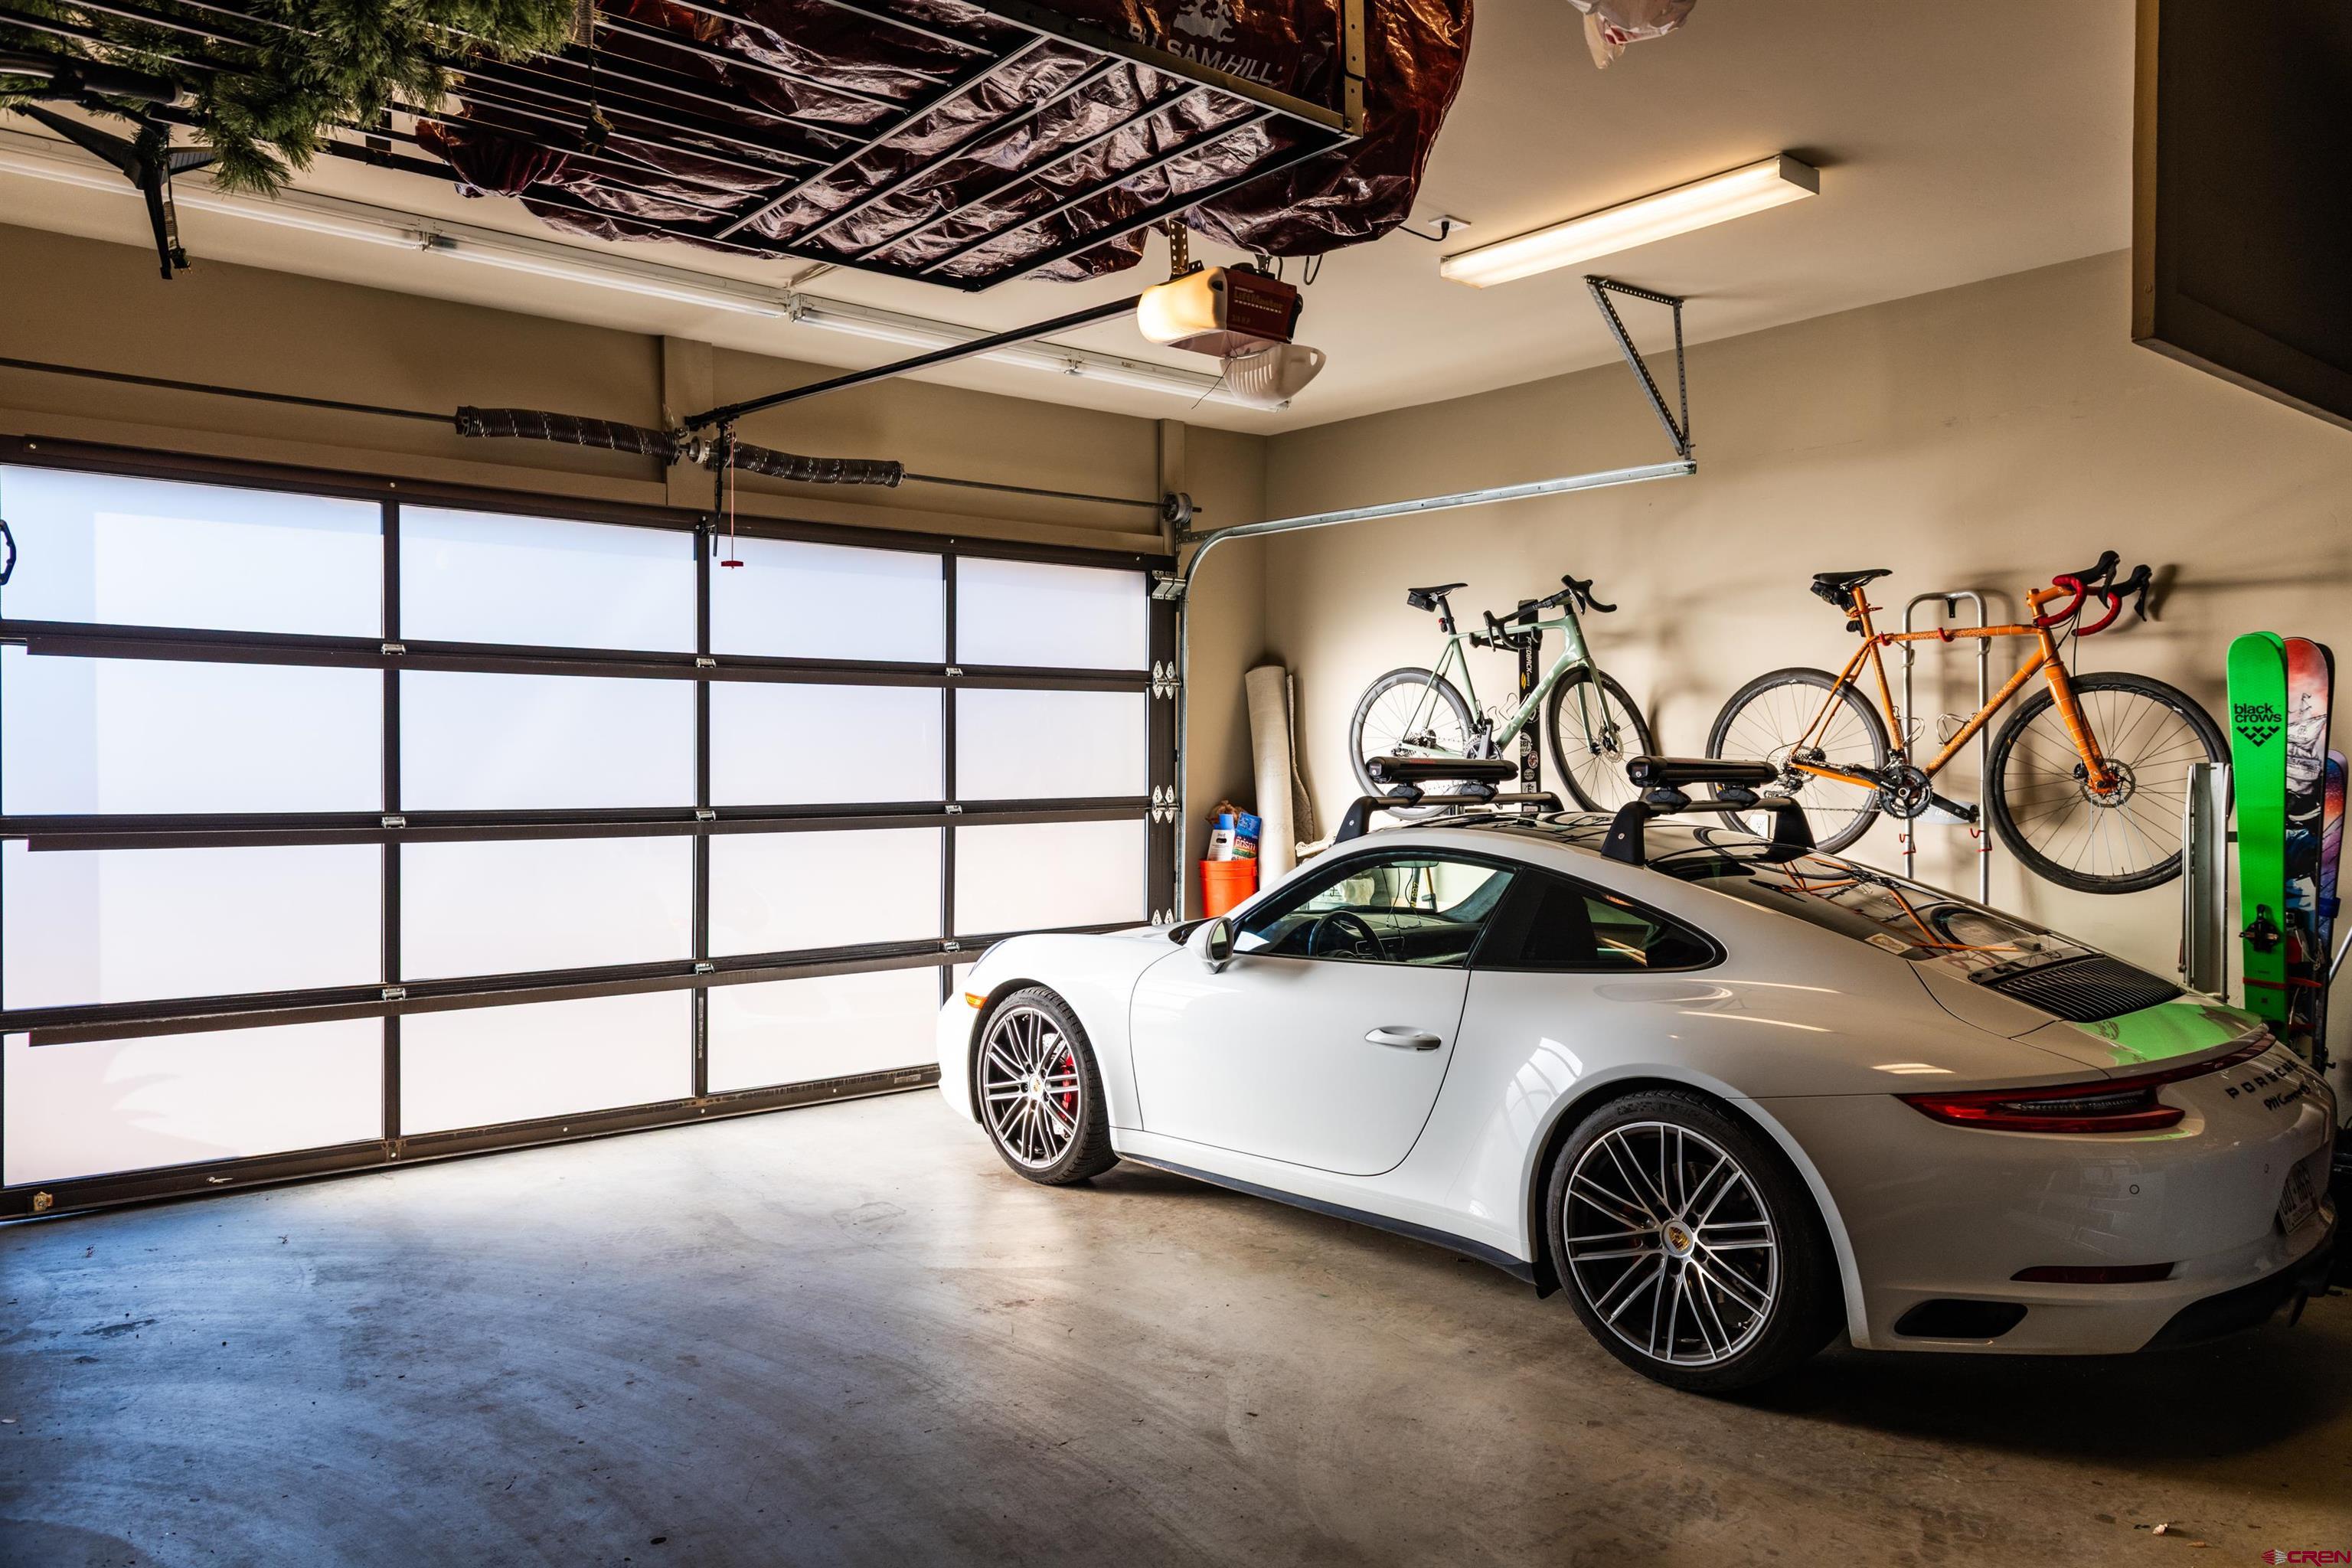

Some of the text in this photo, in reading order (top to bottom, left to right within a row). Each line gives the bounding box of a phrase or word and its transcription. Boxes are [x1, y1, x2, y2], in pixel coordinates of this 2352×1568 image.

[1222, 54, 1274, 84] HILL
[2234, 703, 2273, 714] black
[2234, 714, 2282, 723] crows
[2225, 1059, 2298, 1099] PORSCHE
